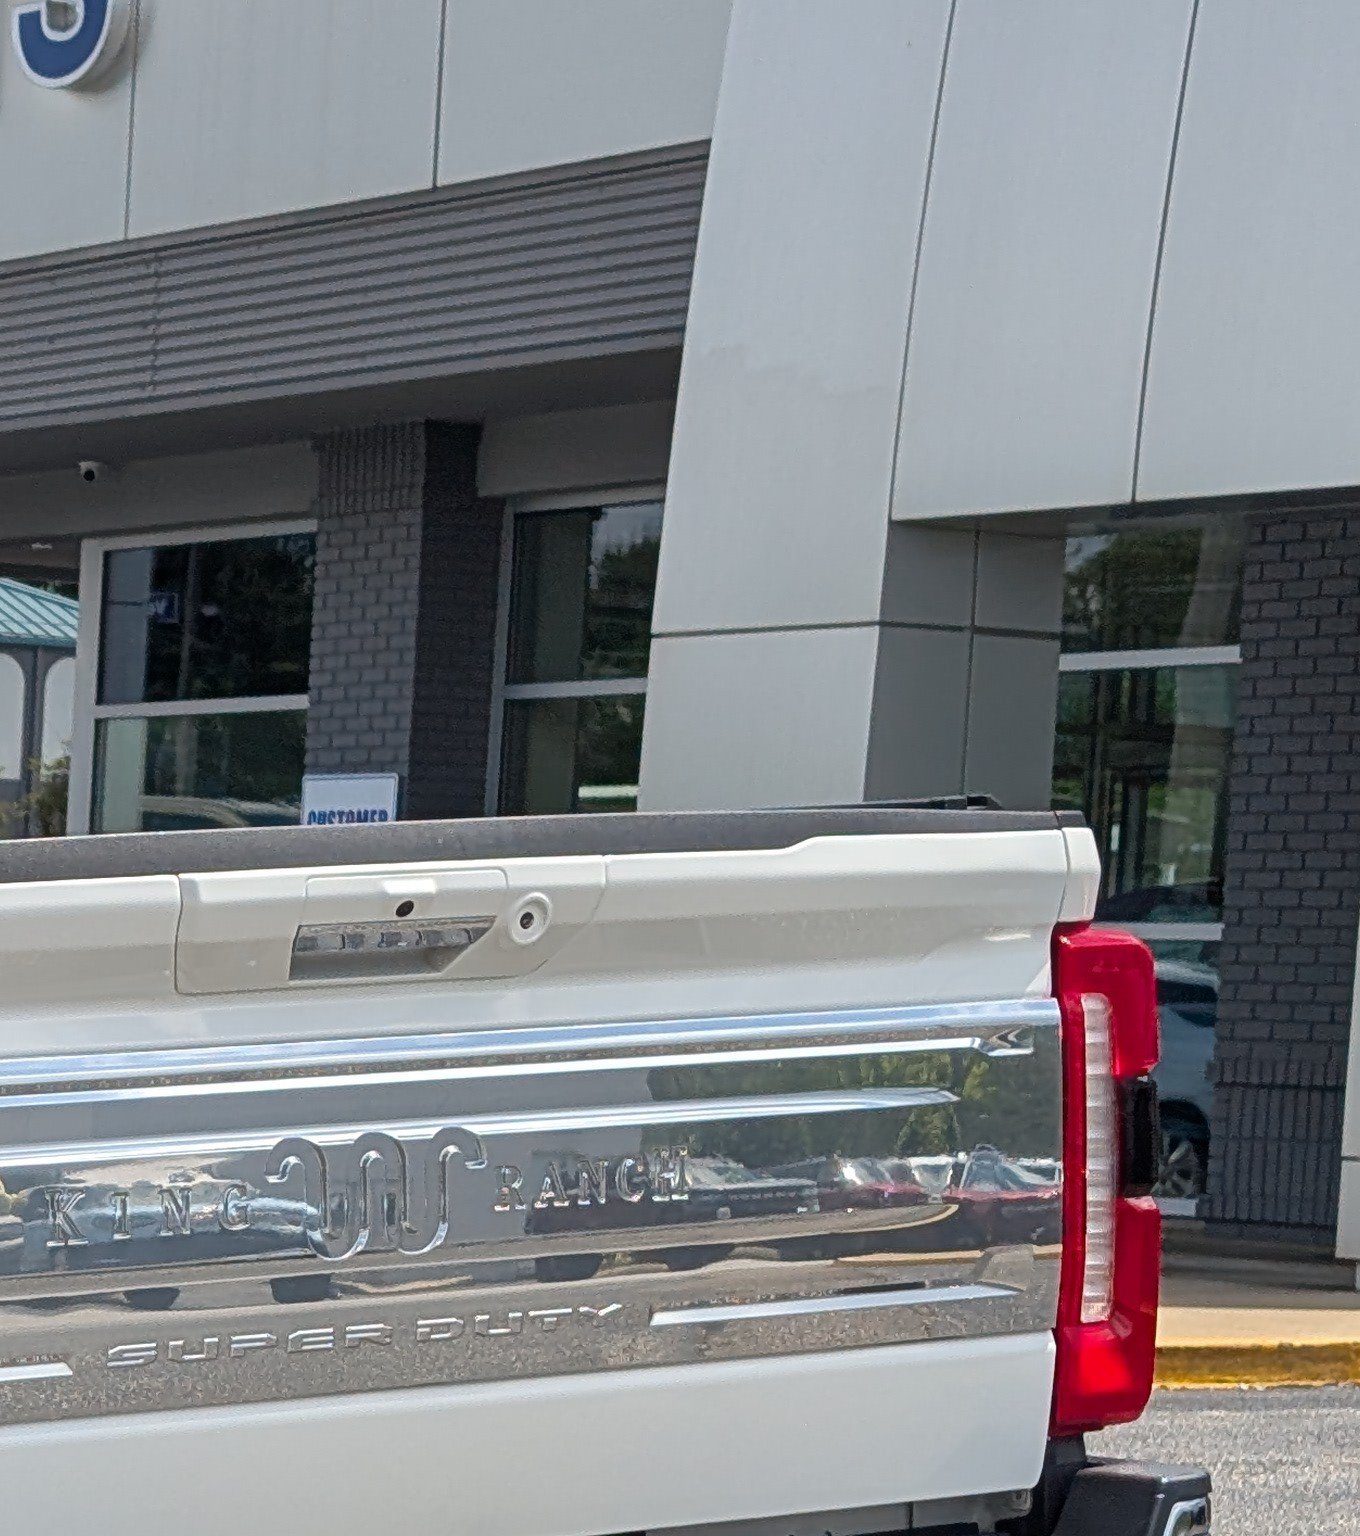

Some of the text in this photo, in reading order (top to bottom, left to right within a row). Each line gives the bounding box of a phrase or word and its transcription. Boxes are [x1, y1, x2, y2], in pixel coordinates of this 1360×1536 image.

[44, 1146, 691, 1247] KING RANCH
[105, 1303, 623, 1368] SUPER DUTY
